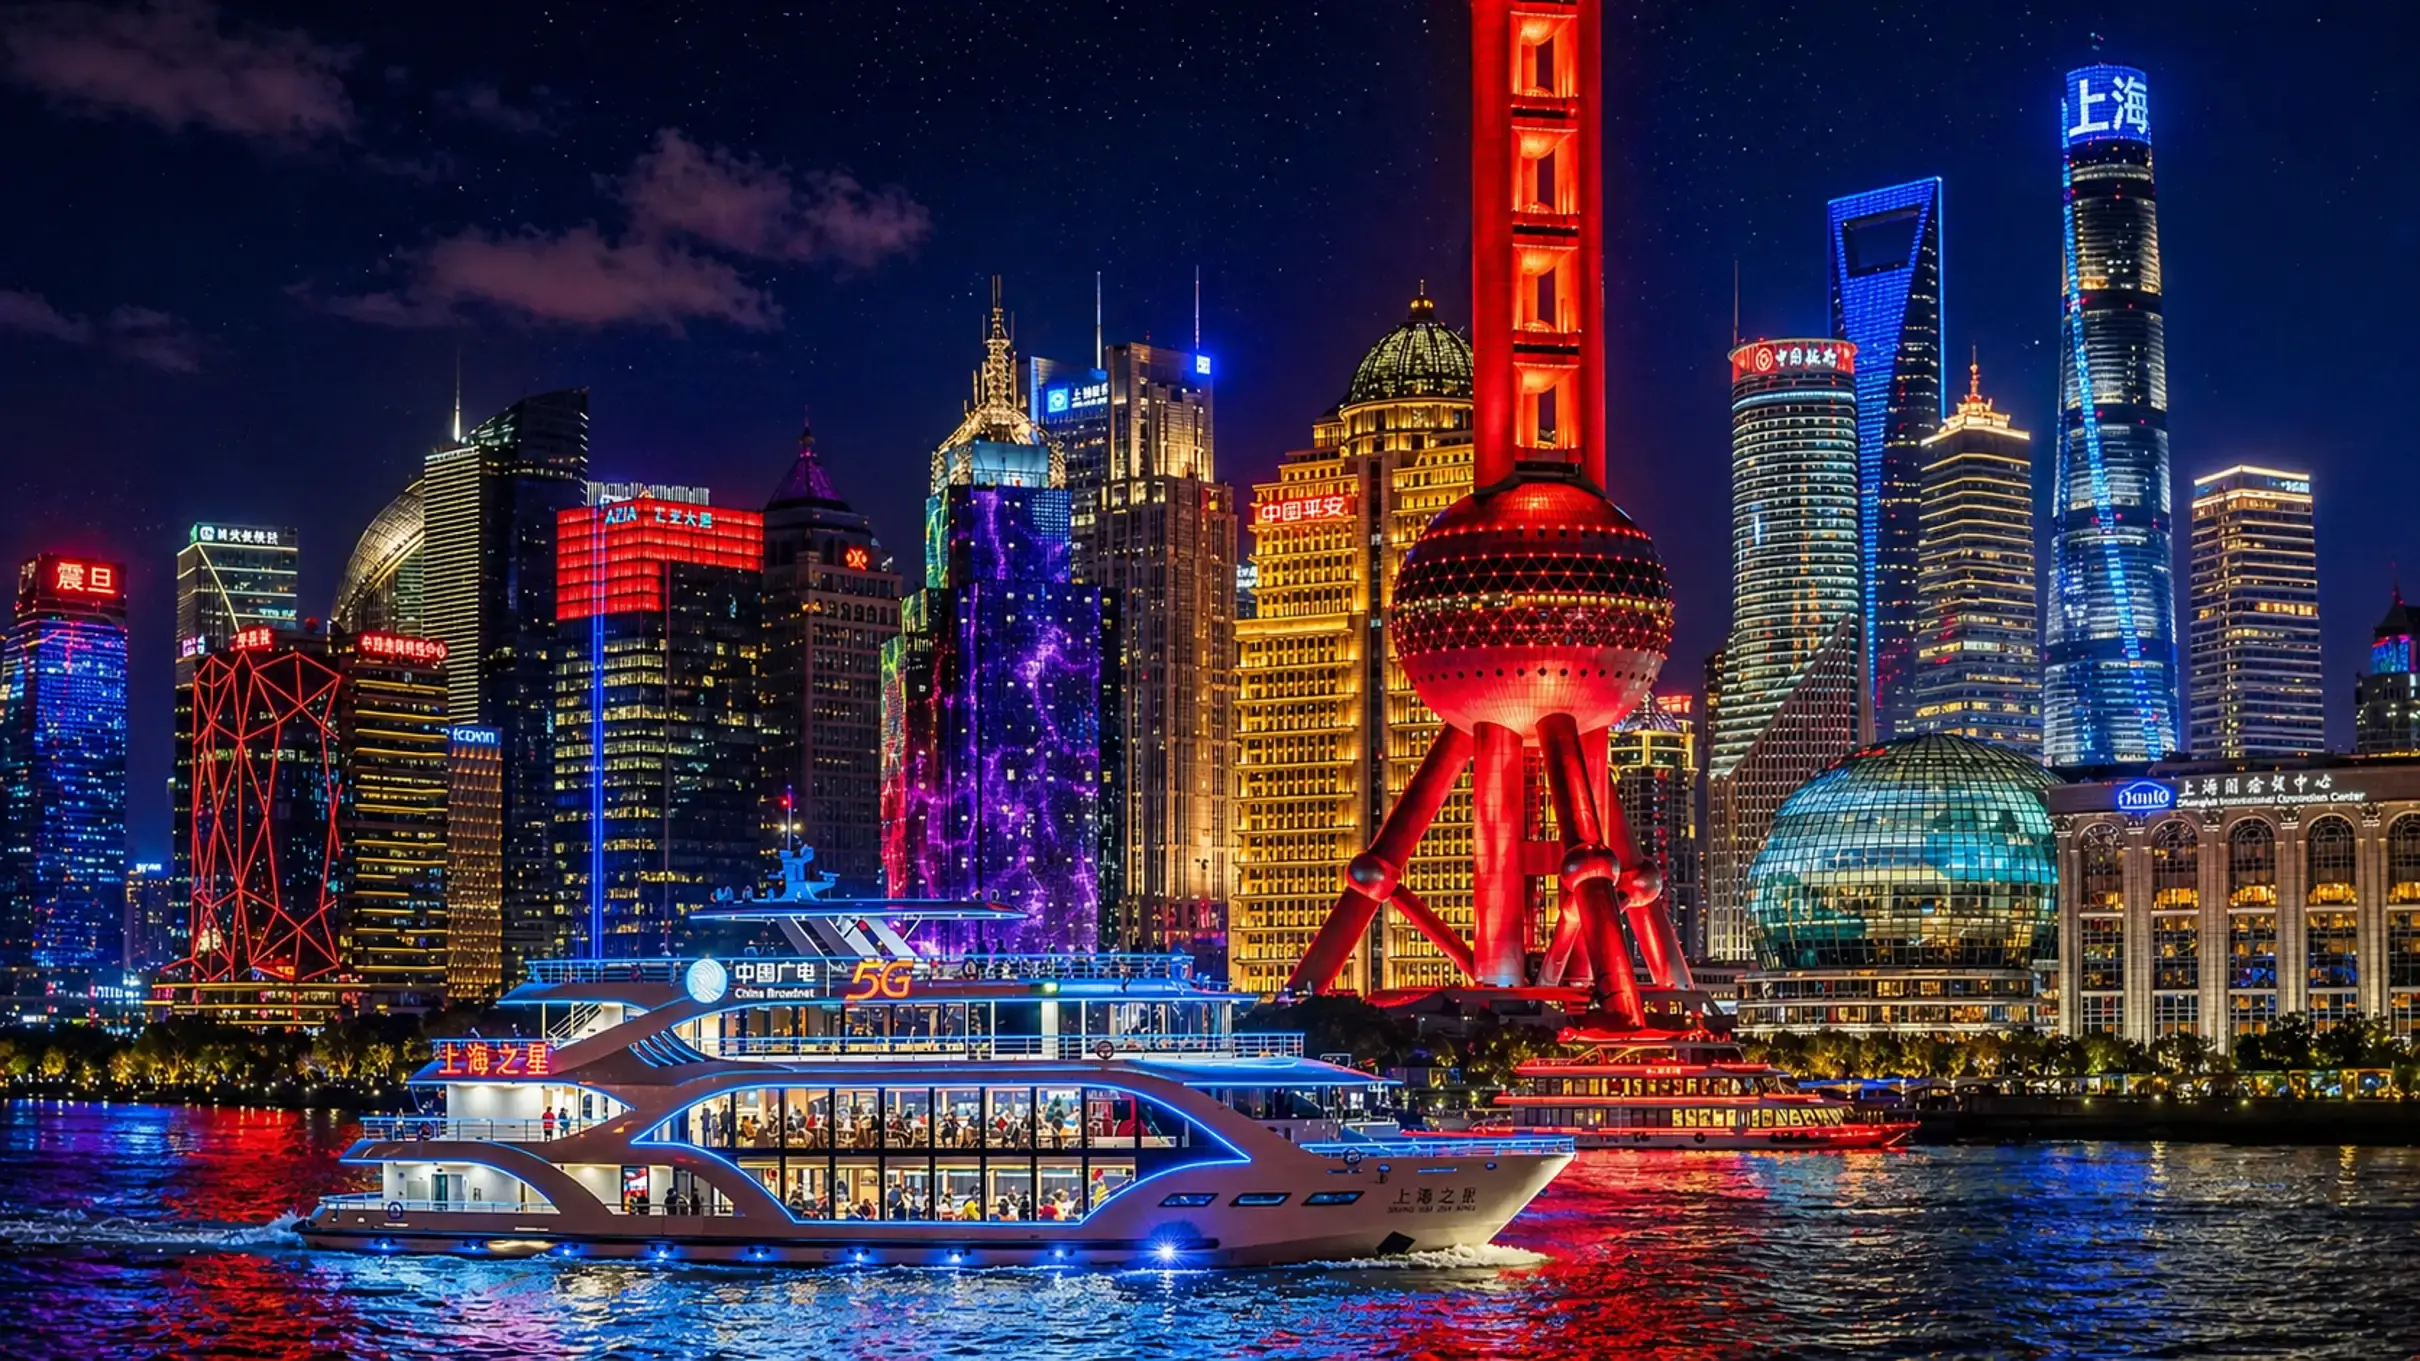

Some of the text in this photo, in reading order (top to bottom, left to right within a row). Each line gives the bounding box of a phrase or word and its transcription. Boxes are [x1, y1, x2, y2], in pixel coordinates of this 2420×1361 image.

[2069, 75, 2148, 138] 上海
[1262, 496, 1348, 523] 中国平安
[57, 562, 115, 594] 震旦
[735, 961, 816, 984] 中国广电
[845, 960, 914, 1001] 5G
[438, 1042, 549, 1076] 上海之星
